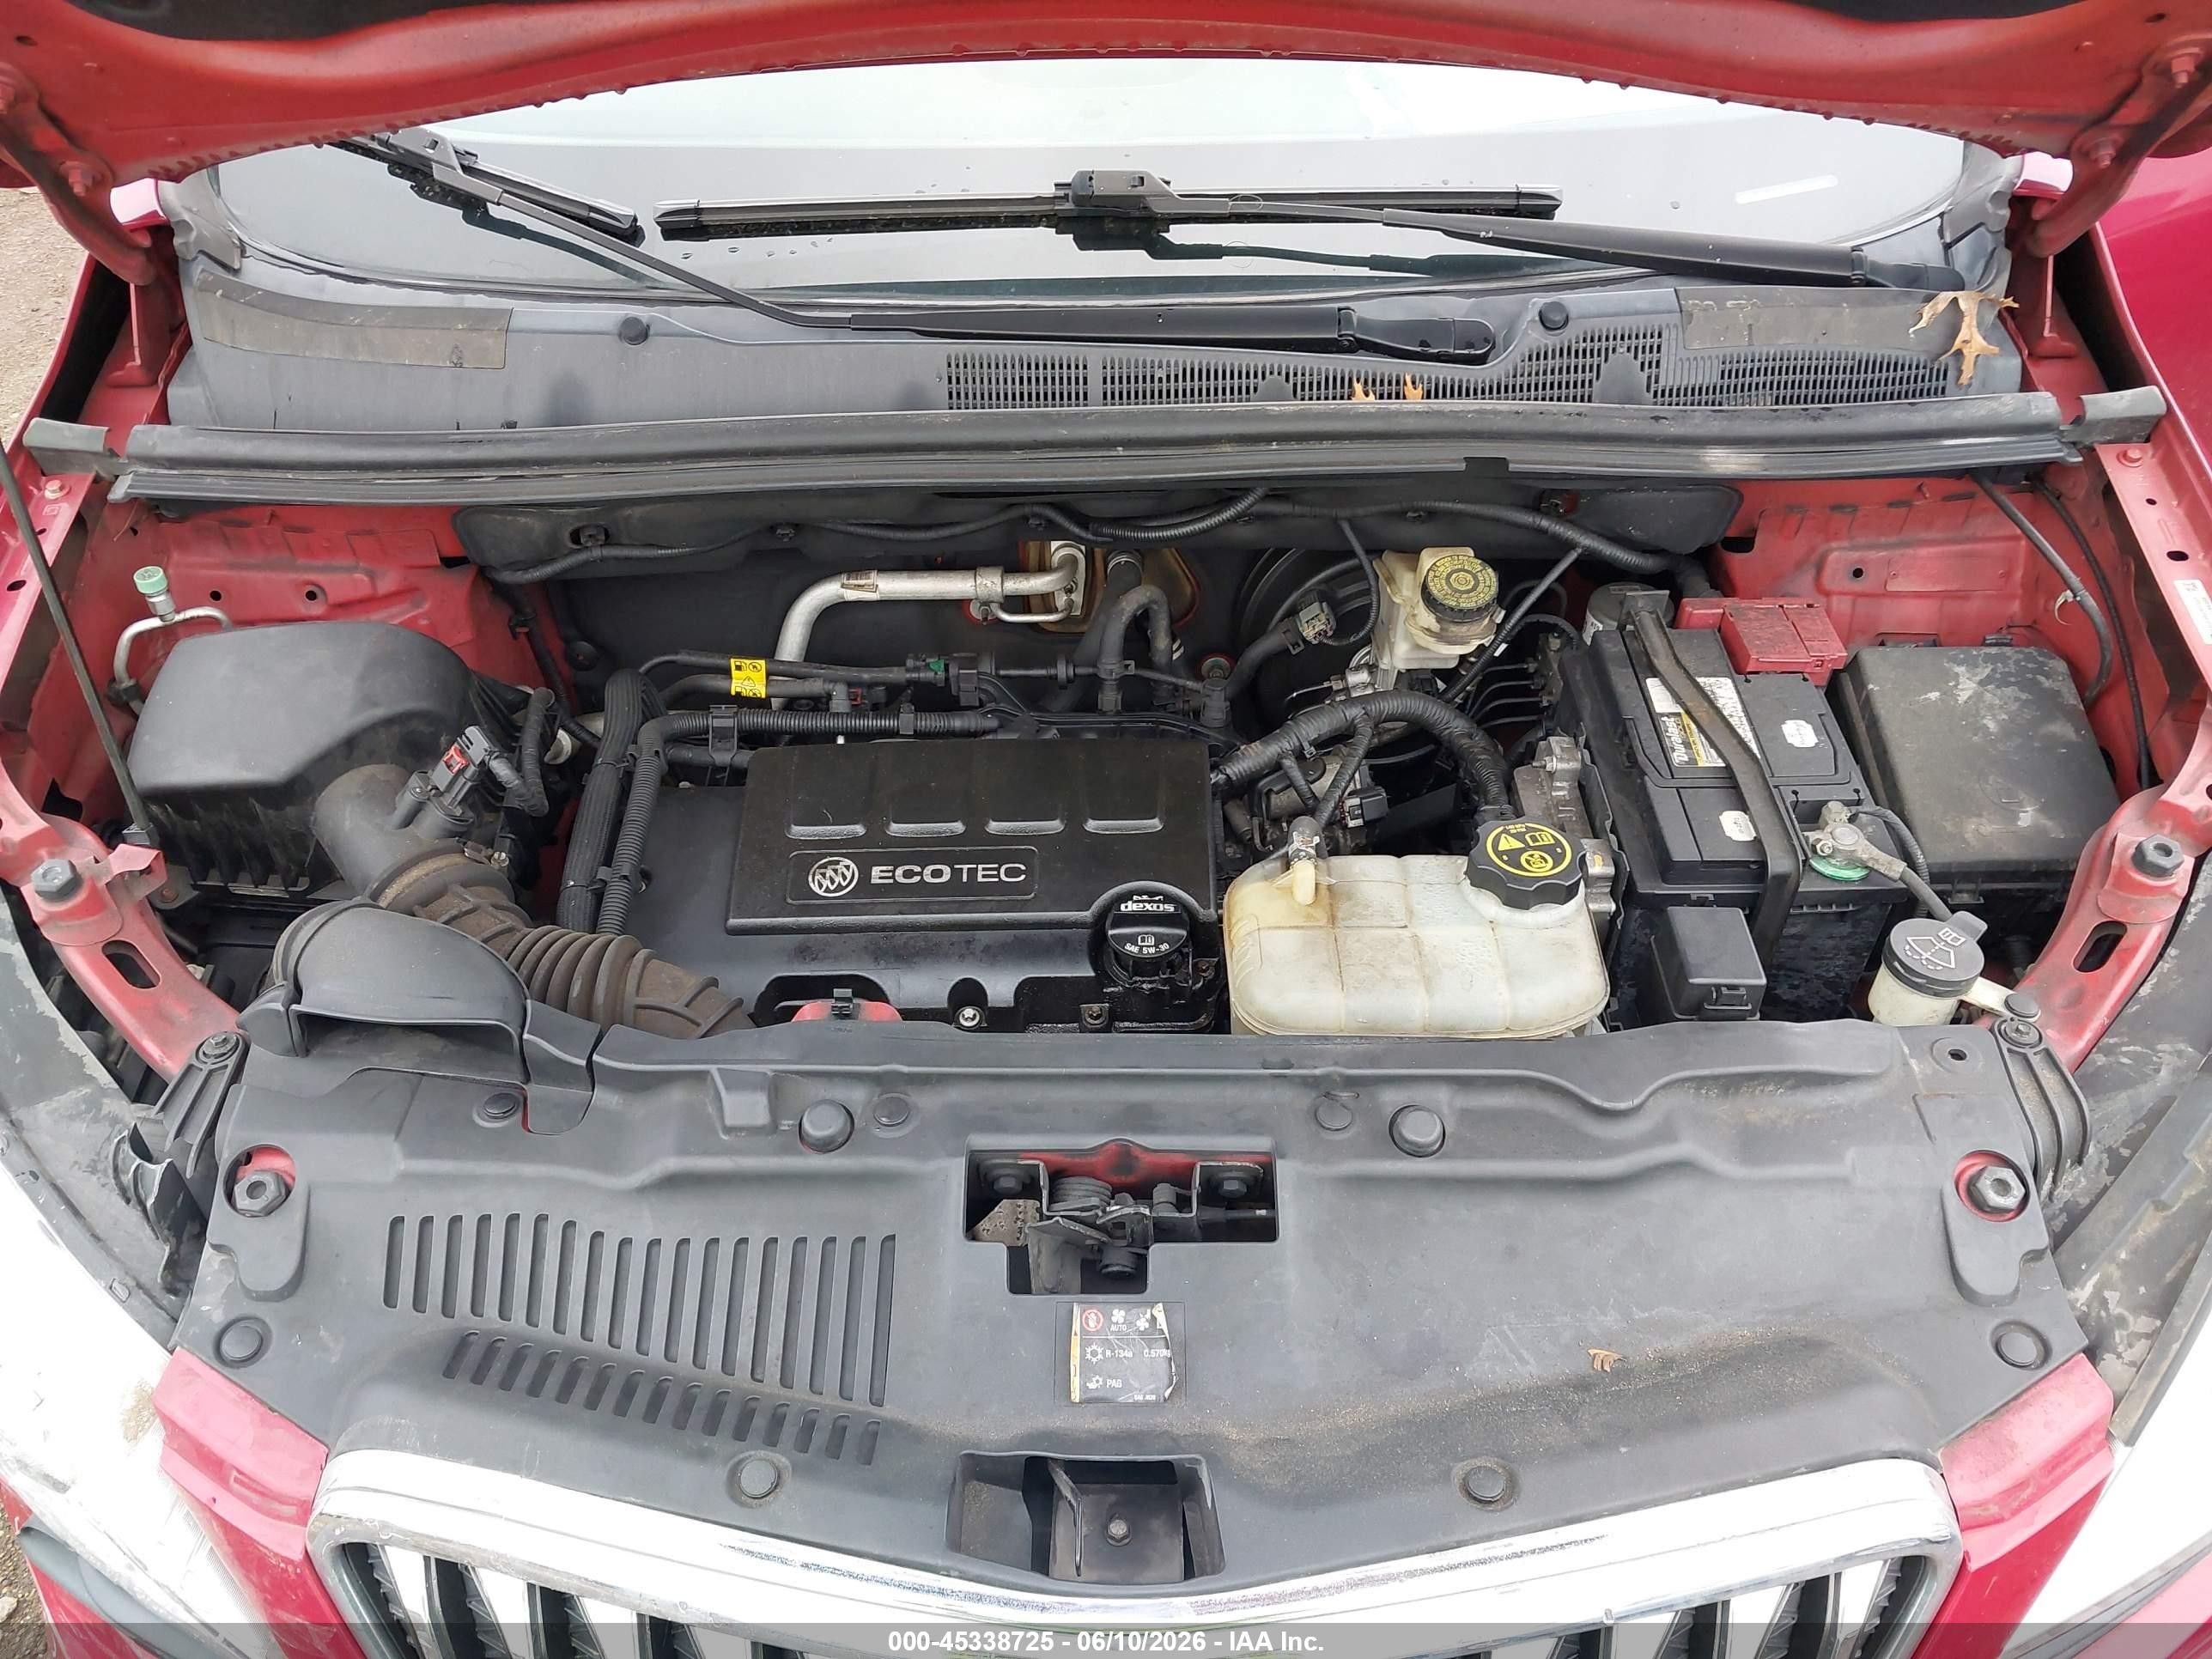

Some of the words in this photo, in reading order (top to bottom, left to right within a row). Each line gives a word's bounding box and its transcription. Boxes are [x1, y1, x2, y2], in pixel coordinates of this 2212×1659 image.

[1661, 716, 1689, 763] Duralast
[870, 863, 1026, 884] ECOTEC
[1120, 901, 1176, 912] dexos
[1124, 943, 1139, 953] SAE
[1142, 943, 1170, 954] 5W-30
[1109, 1323, 1127, 1332] AUTO
[1105, 1349, 1133, 1358] R-134a
